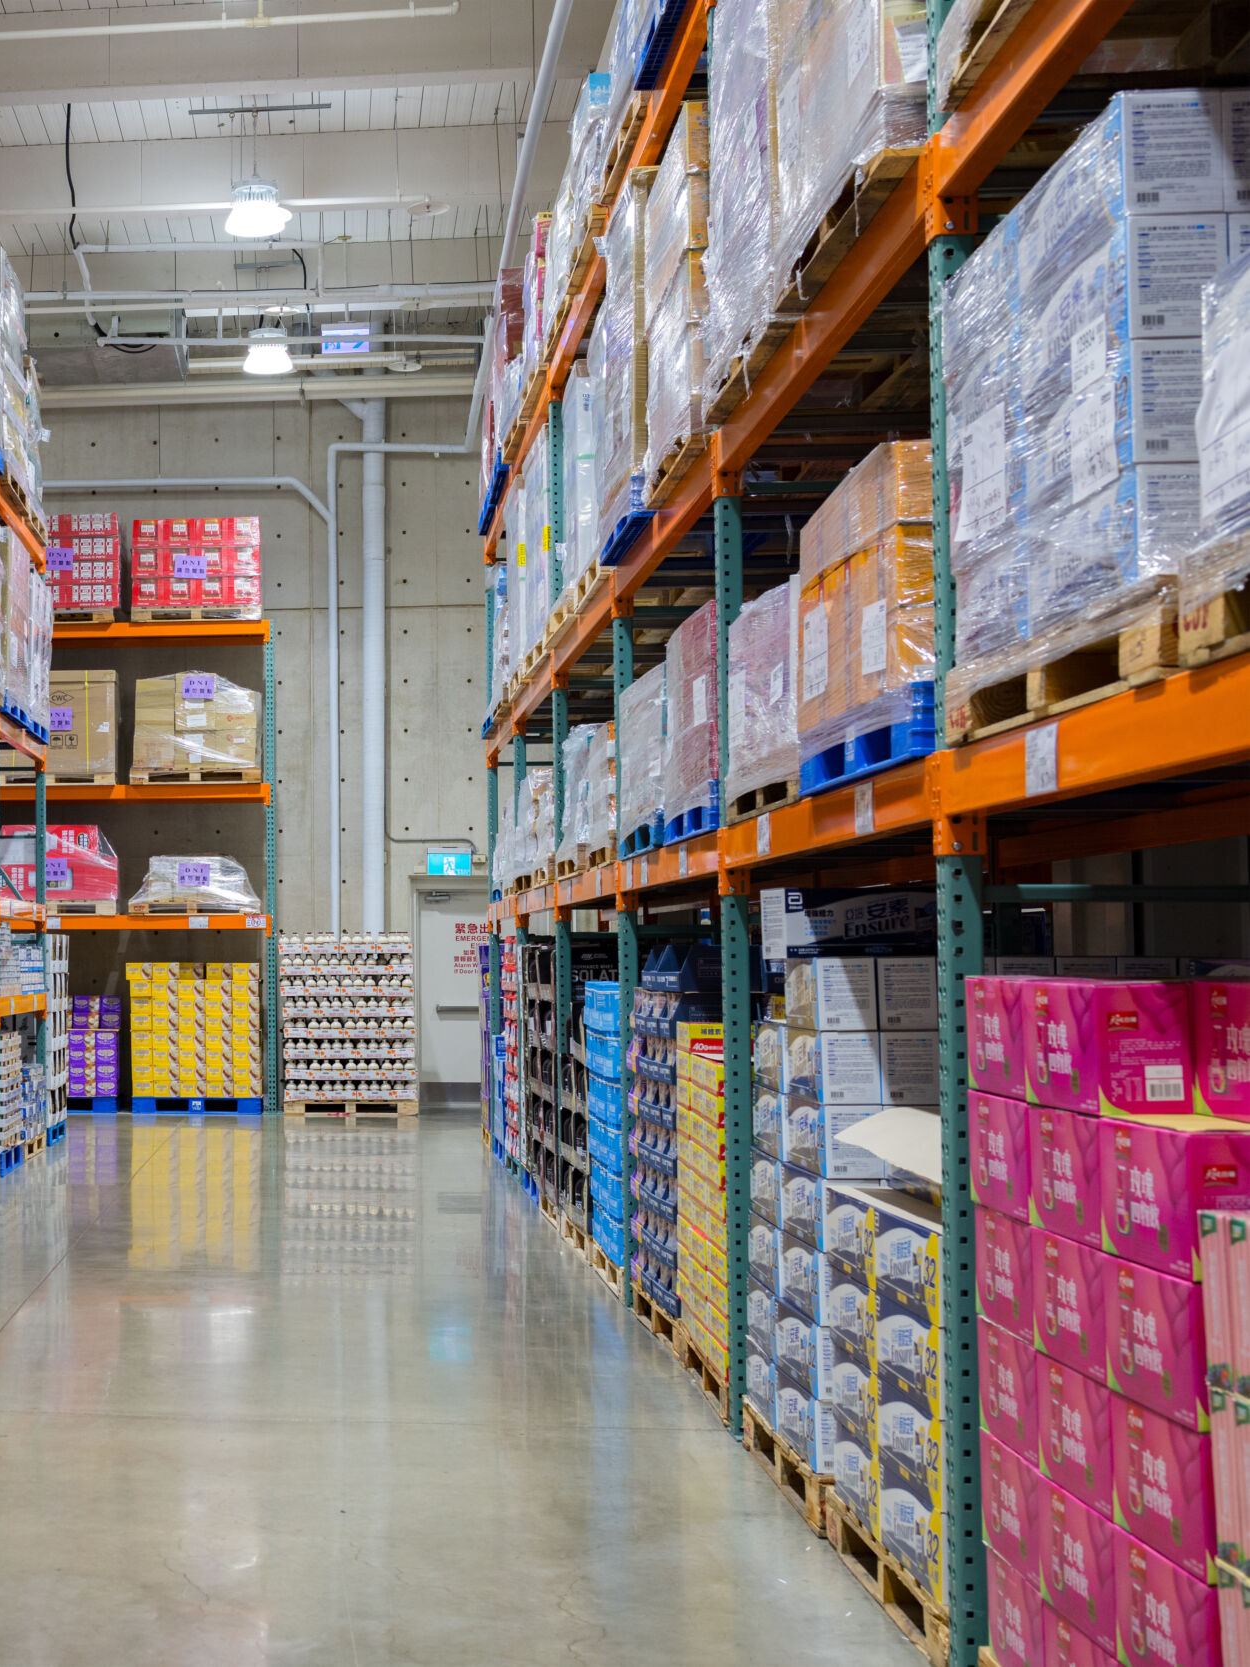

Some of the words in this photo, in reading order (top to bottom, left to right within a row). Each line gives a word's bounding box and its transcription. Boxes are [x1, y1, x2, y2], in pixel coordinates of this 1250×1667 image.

[51, 693, 68, 701] CWC
[455, 923, 488, 934] 緊急出
[844, 915, 910, 940] Ensure
[571, 969, 618, 982] SOLAT
[864, 1228, 874, 1258] 32
[924, 1255, 936, 1288] 32
[865, 1311, 875, 1342] 32
[924, 1345, 938, 1381] 32
[866, 1395, 876, 1424] 32
[926, 1437, 940, 1472] 32
[867, 1478, 877, 1508] 32
[926, 1531, 940, 1565] 32
